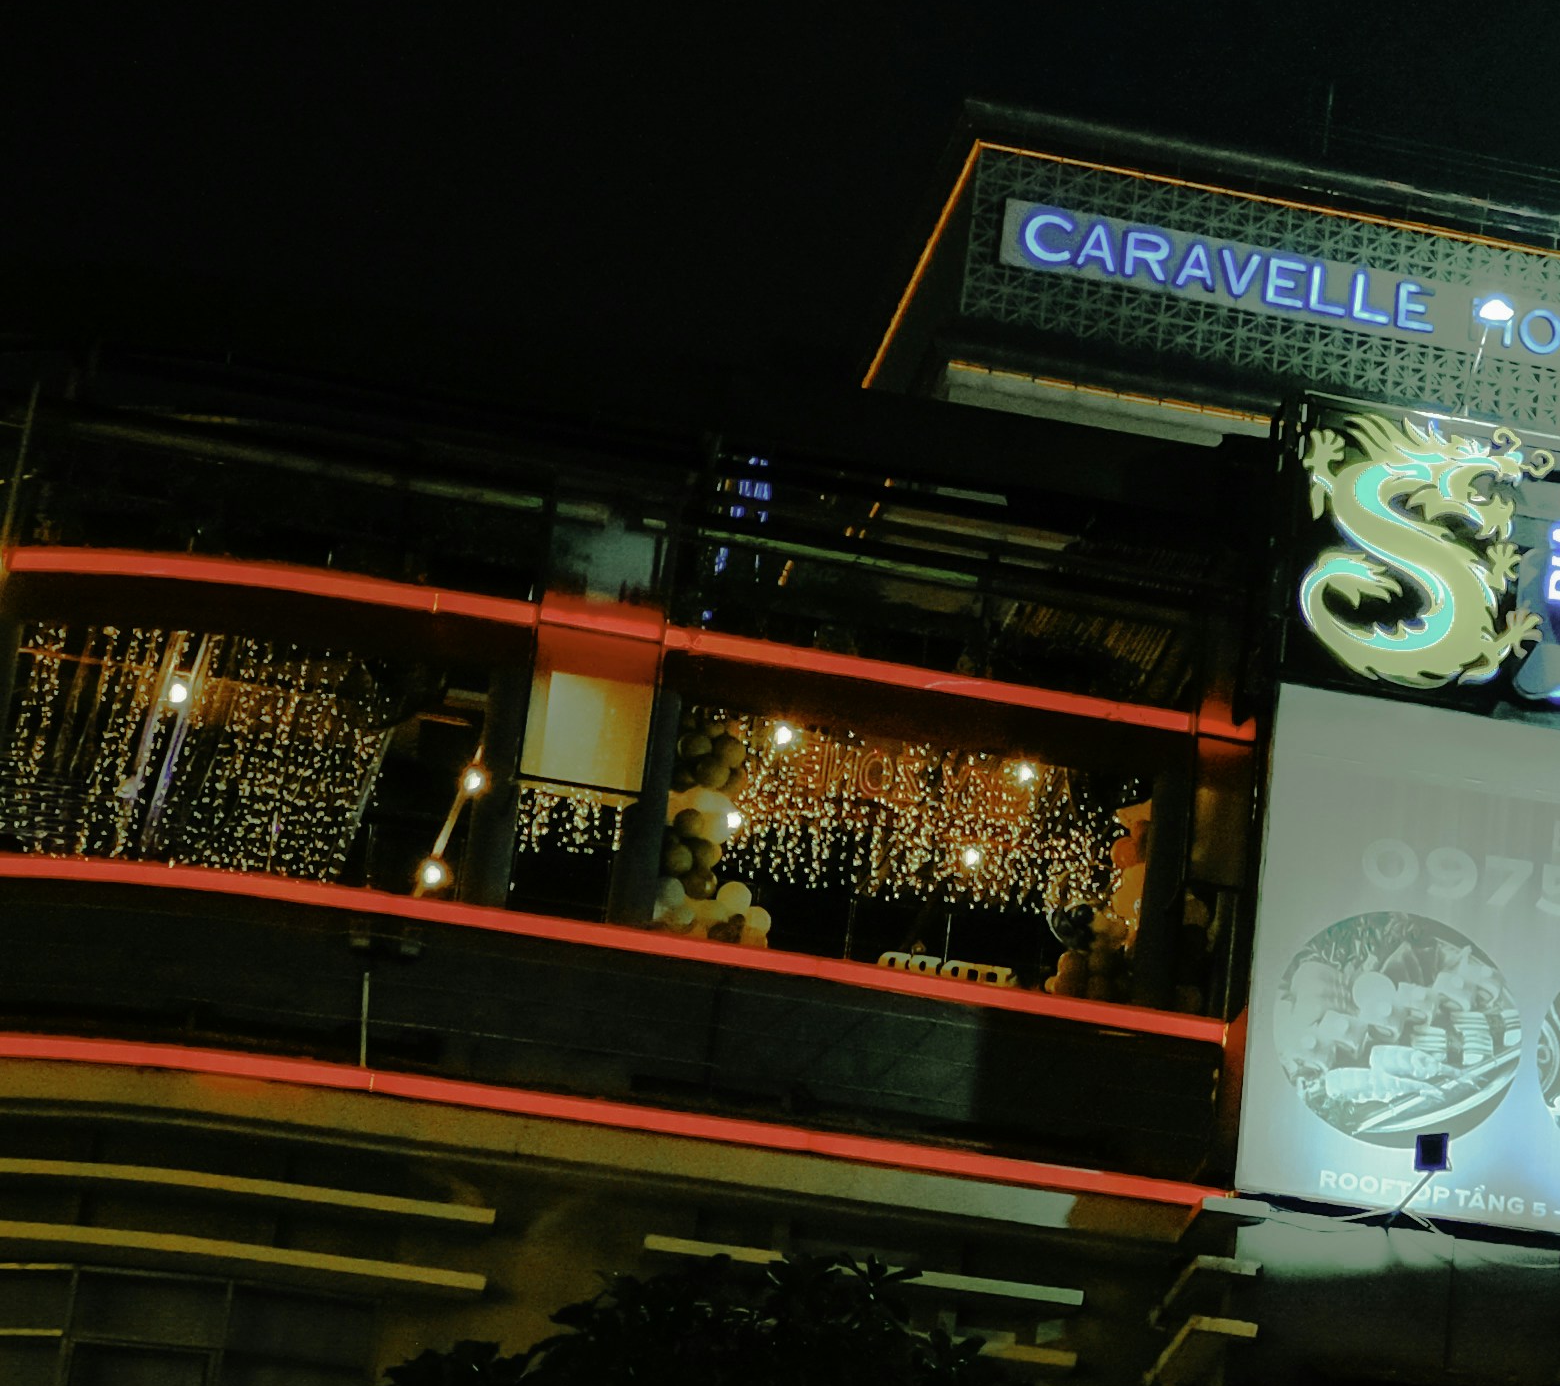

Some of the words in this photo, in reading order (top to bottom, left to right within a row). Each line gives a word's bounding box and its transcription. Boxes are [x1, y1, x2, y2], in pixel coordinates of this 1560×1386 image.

[1021, 213, 1437, 334] CARAVELLE
[1318, 1169, 1450, 1205] ROOFTOP
[1530, 1201, 1547, 1217] 5
